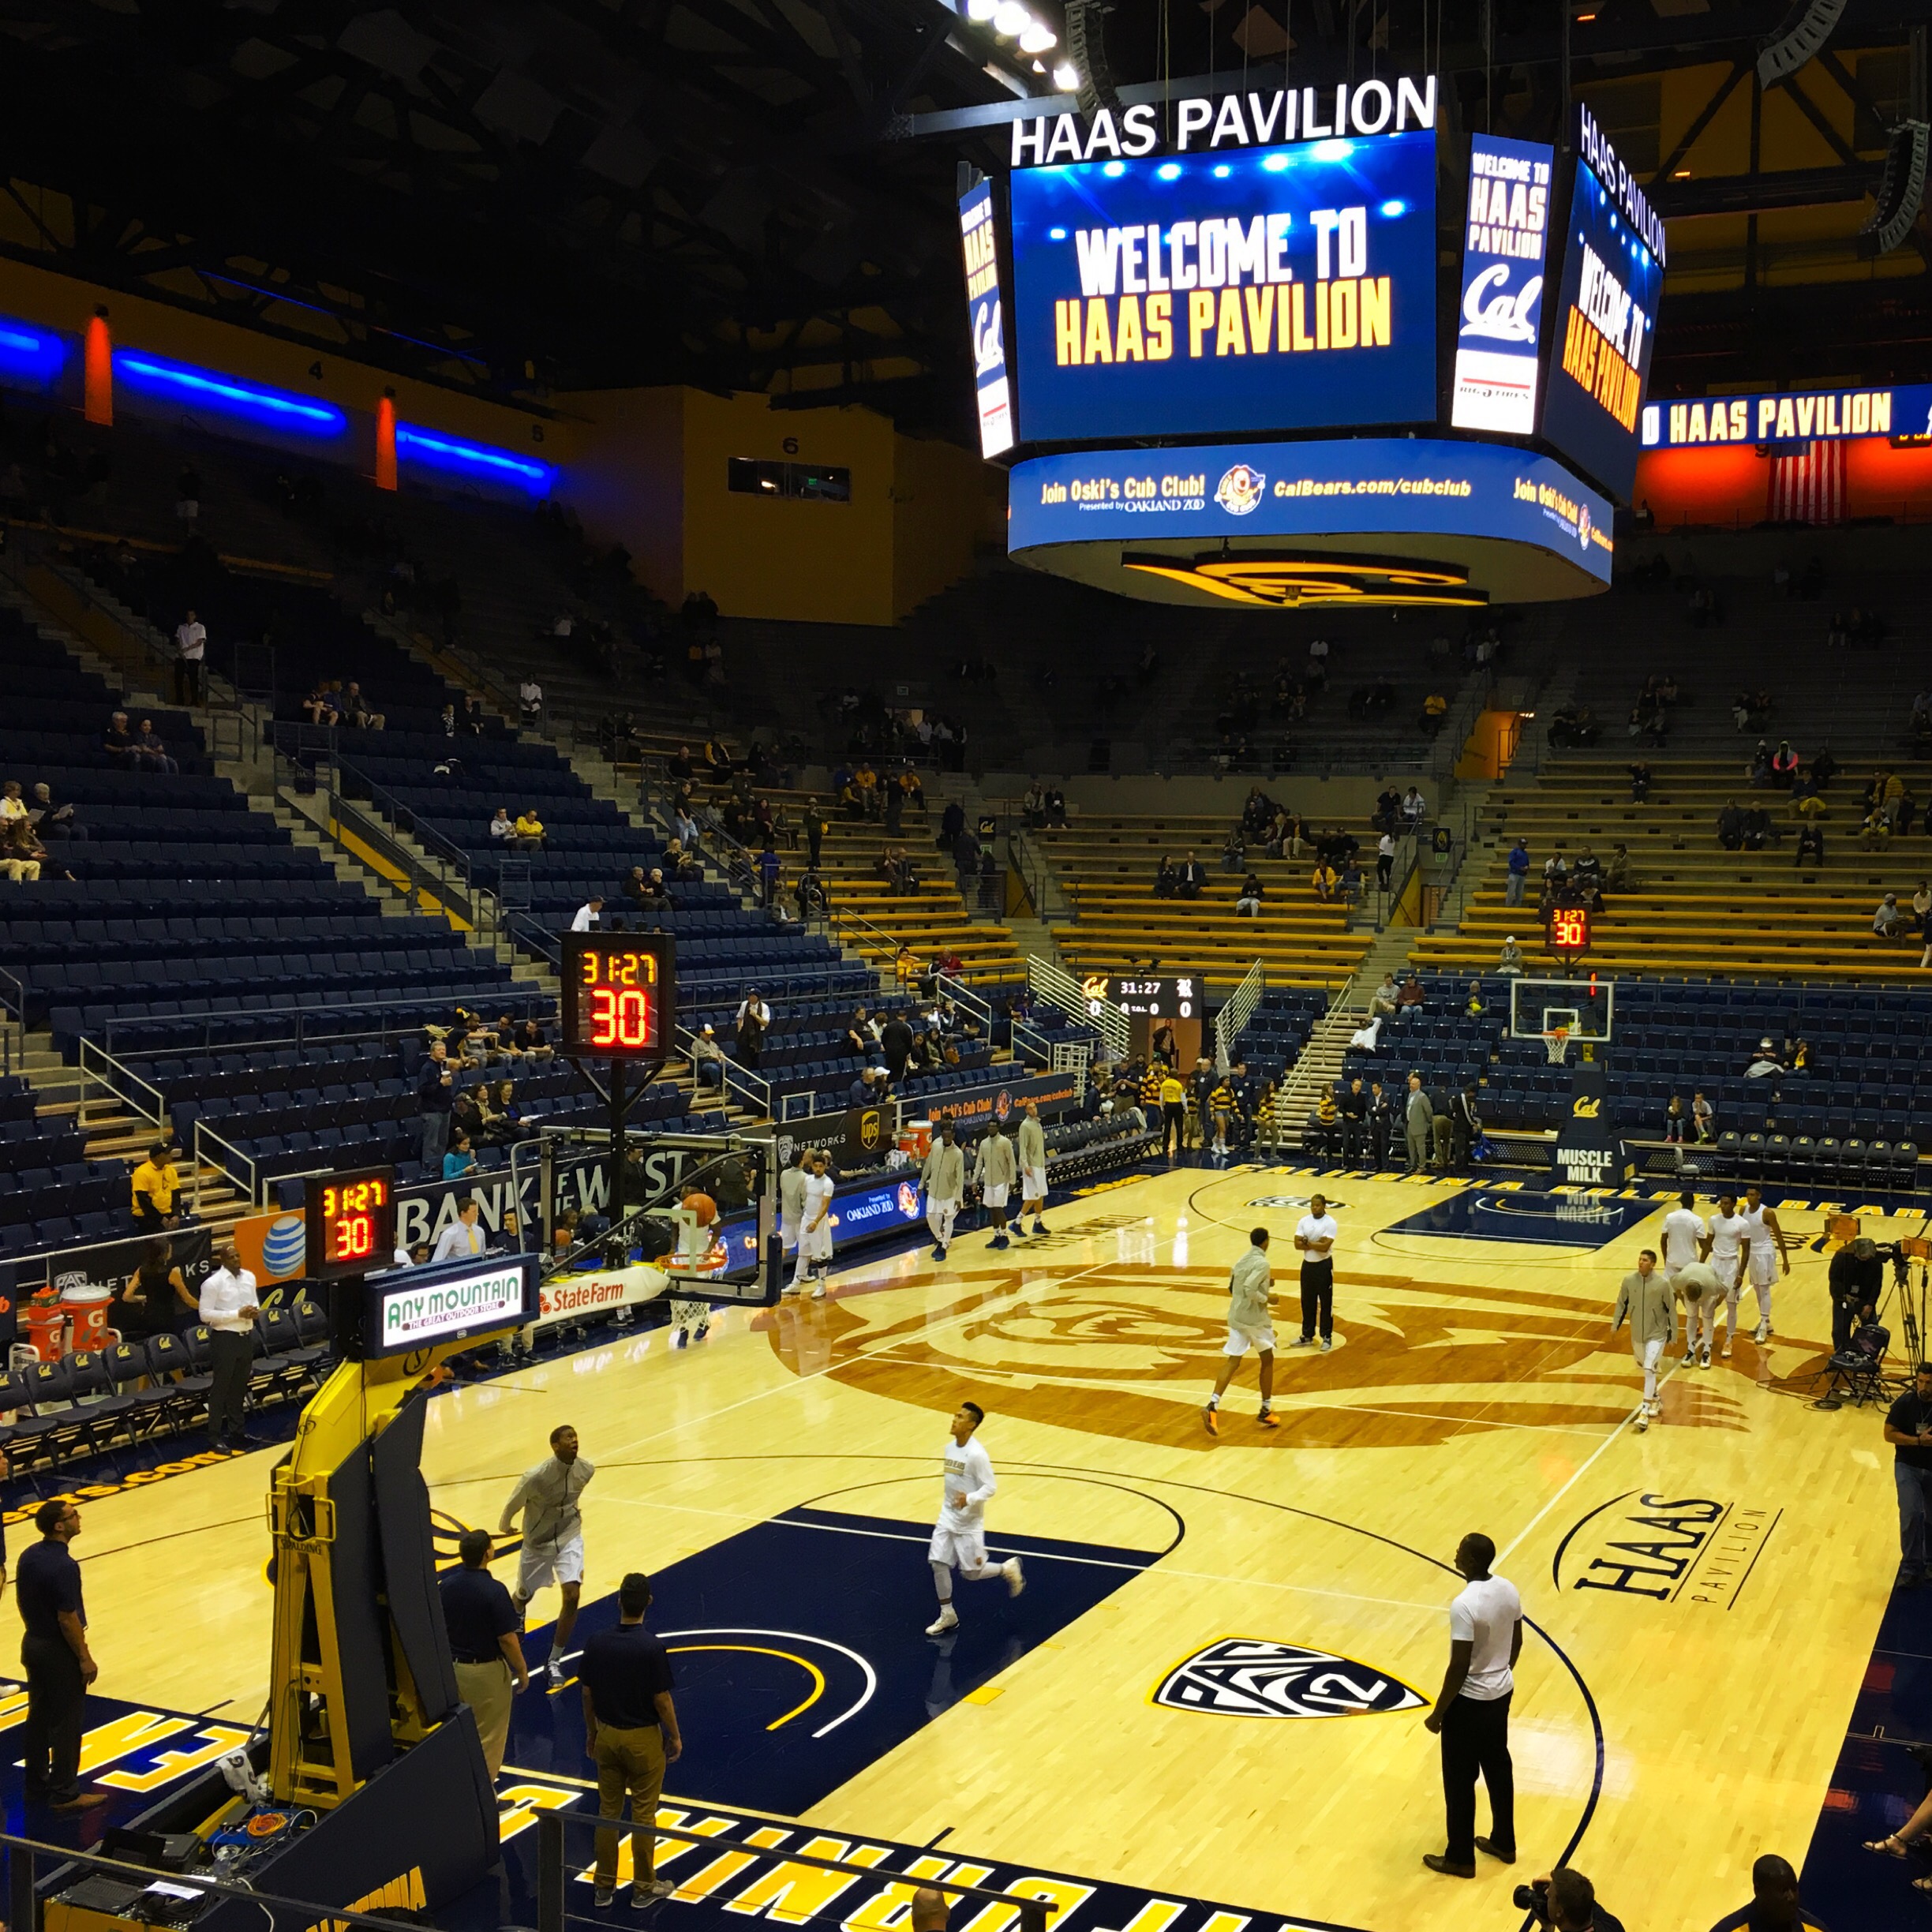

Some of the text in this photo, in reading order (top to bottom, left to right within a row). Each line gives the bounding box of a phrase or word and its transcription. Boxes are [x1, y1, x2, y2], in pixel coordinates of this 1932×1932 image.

[1011, 76, 1436, 166] HAAS PAVILION
[1473, 152, 1549, 185] WELCOME TO
[1581, 103, 1665, 267] HAAS PAVILION
[1470, 177, 1546, 231] HAAS
[1076, 207, 1366, 296] WELCOME TO
[1469, 224, 1541, 260] PAVILION
[1460, 264, 1543, 344] Cal
[1578, 243, 1632, 356] WELCOME
[1055, 276, 1391, 365] HAAS PAVILION
[974, 300, 1004, 377] Cal
[309, 360, 324, 380] 4
[1563, 304, 1641, 434] HAAS PAVILION
[1670, 401, 1747, 443] HAAS
[1758, 393, 1891, 438] PAVILION
[782, 436, 799, 455] 6
[1041, 482, 1065, 504] Join
[1071, 478, 1119, 501] Oski's
[1124, 477, 1156, 499] Cub
[1161, 474, 1205, 496] Club!
[1274, 478, 1471, 496] CalBears.com/cubclub
[1513, 477, 1537, 502] Join
[1079, 499, 1205, 513] Presented by OAKLAND ZOO
[1553, 909, 1585, 922] 31:27
[1556, 923, 1581, 944] 30
[582, 952, 656, 984] 31:27
[1083, 977, 1109, 997] Cal
[1121, 982, 1161, 994] 31:27
[592, 990, 646, 1044] 30
[1150, 1003, 1159, 1015] 0
[1180, 1002, 1192, 1017] 0
[928, 1107, 942, 1121] Join
[964, 1100, 975, 1115] Cub
[976, 1097, 993, 1113] Club!
[1573, 1095, 1601, 1118] Cal
[793, 1133, 846, 1151] NETWORKS
[1557, 1148, 1612, 1166] MUSCLE
[576, 1151, 690, 1209] WST
[1227, 1164, 1524, 1190] CALIFORNIA
[324, 1181, 382, 1217] 31:27
[846, 1203, 881, 1222] OAKLAND
[336, 1217, 370, 1256] 30
[88, 1309, 103, 1327] G
[388, 1276, 519, 1330] ANY MOUNTAIN
[409, 1301, 500, 1330] THE GREAT OUTDOOR STORE
[49, 1329, 61, 1343] G
[1574, 1494, 1724, 1601] HAAS
[1691, 1509, 1767, 1604] PAVILION
